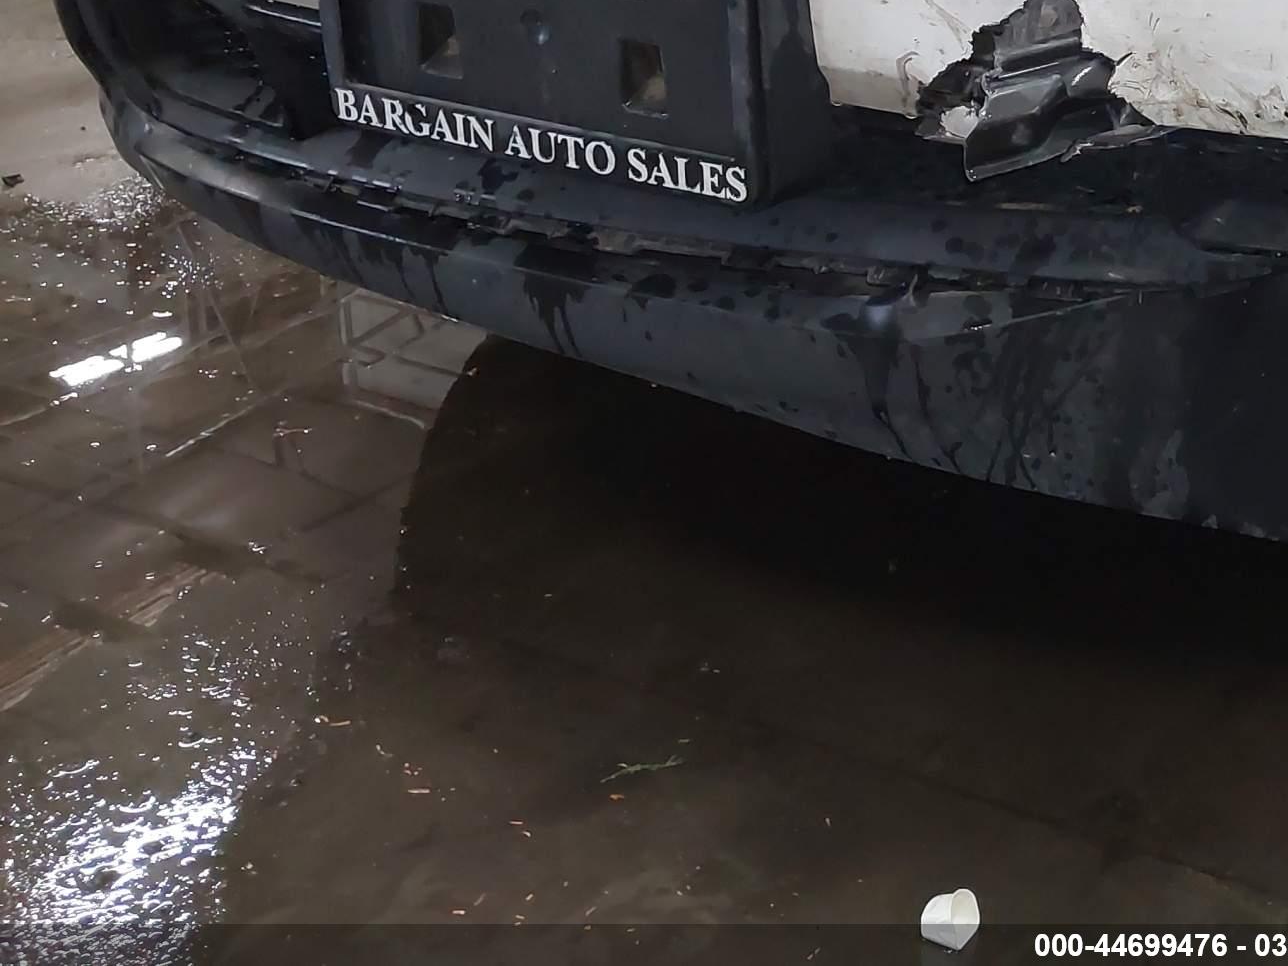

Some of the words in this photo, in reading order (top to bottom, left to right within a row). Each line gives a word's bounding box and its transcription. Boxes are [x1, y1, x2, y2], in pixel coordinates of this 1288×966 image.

[333, 87, 495, 153] BARGAIN
[504, 124, 617, 176] AUTO
[628, 147, 748, 203] SALES
